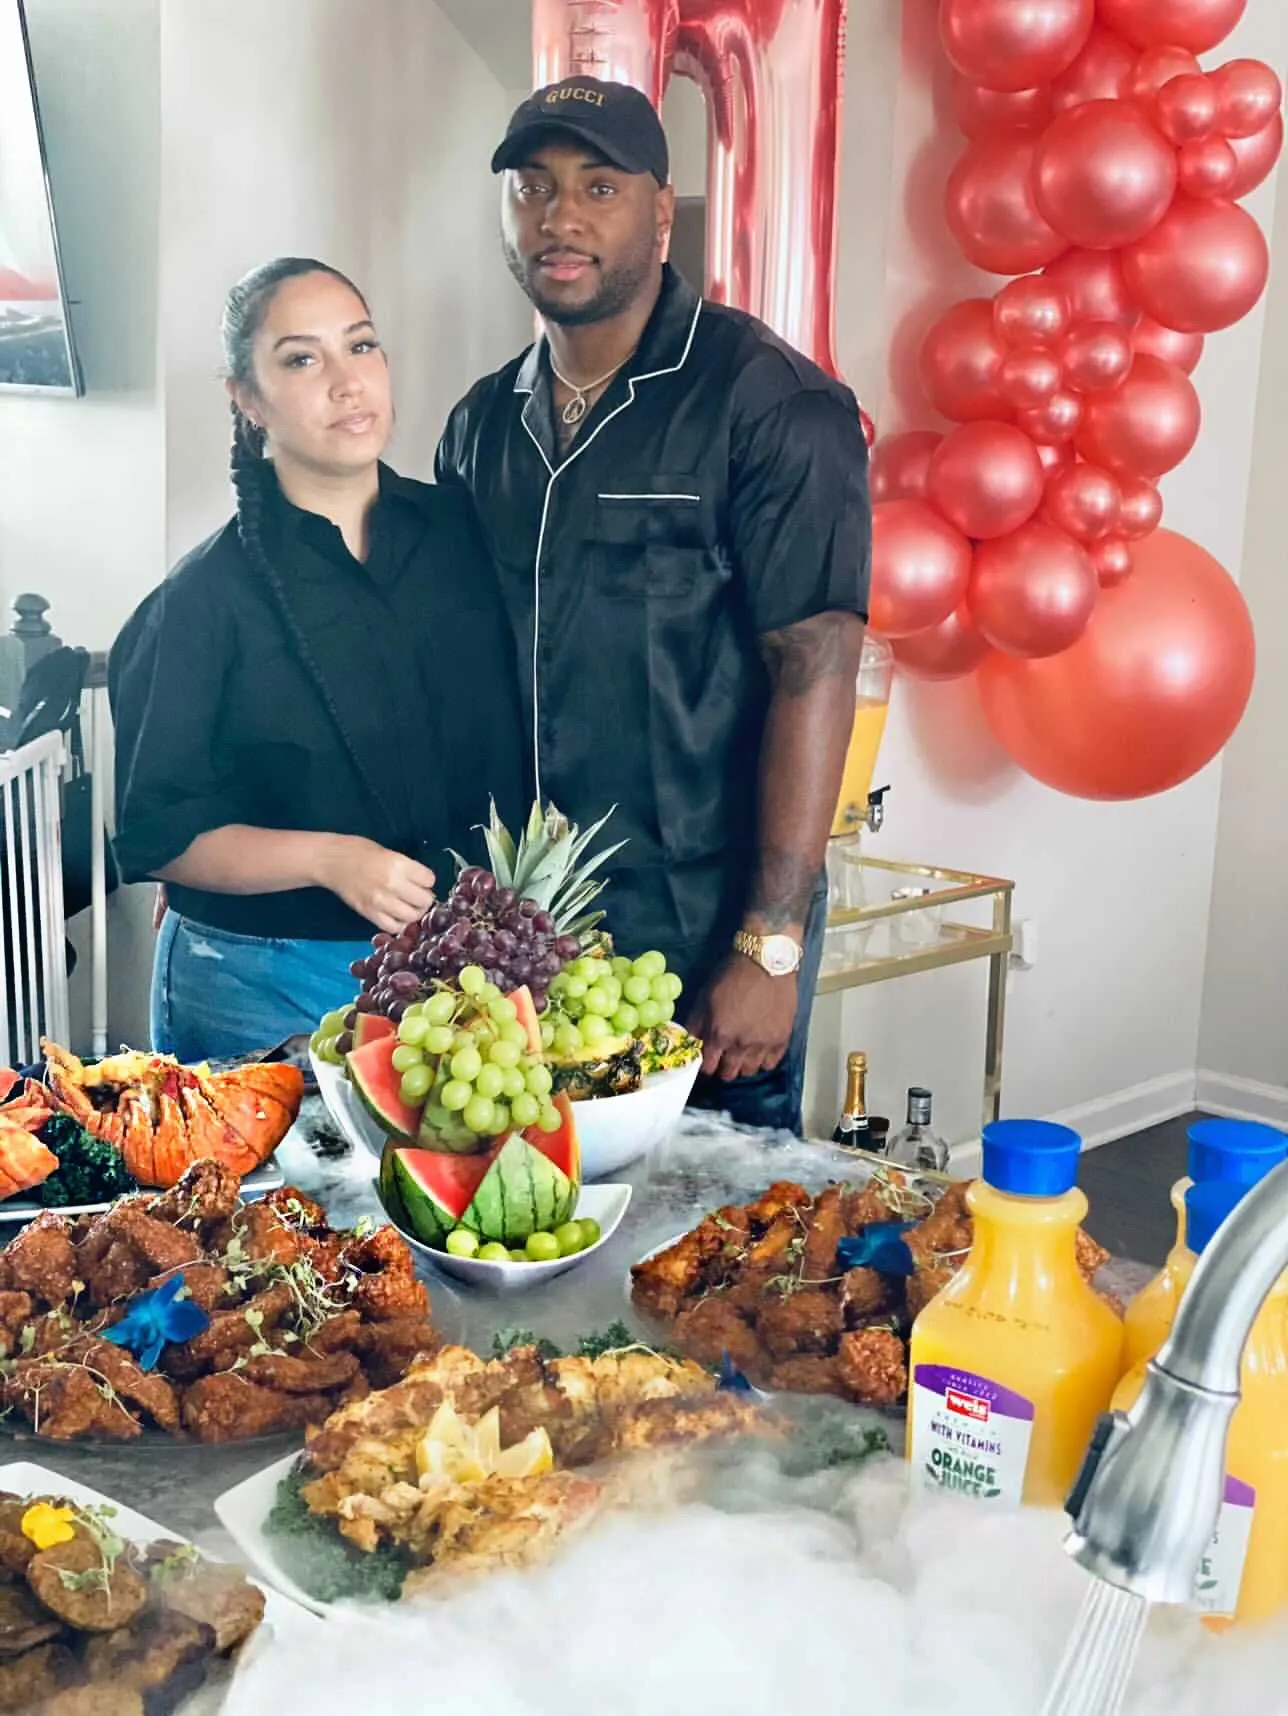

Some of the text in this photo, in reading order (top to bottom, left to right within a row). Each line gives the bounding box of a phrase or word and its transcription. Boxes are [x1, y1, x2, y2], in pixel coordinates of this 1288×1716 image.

[545, 87, 605, 107] GUCCI
[930, 1420, 953, 1441] WITH
[956, 1431, 1001, 1456] VITAMINS
[931, 1447, 996, 1486] ORANGE
[938, 1470, 982, 1497] JUICE
